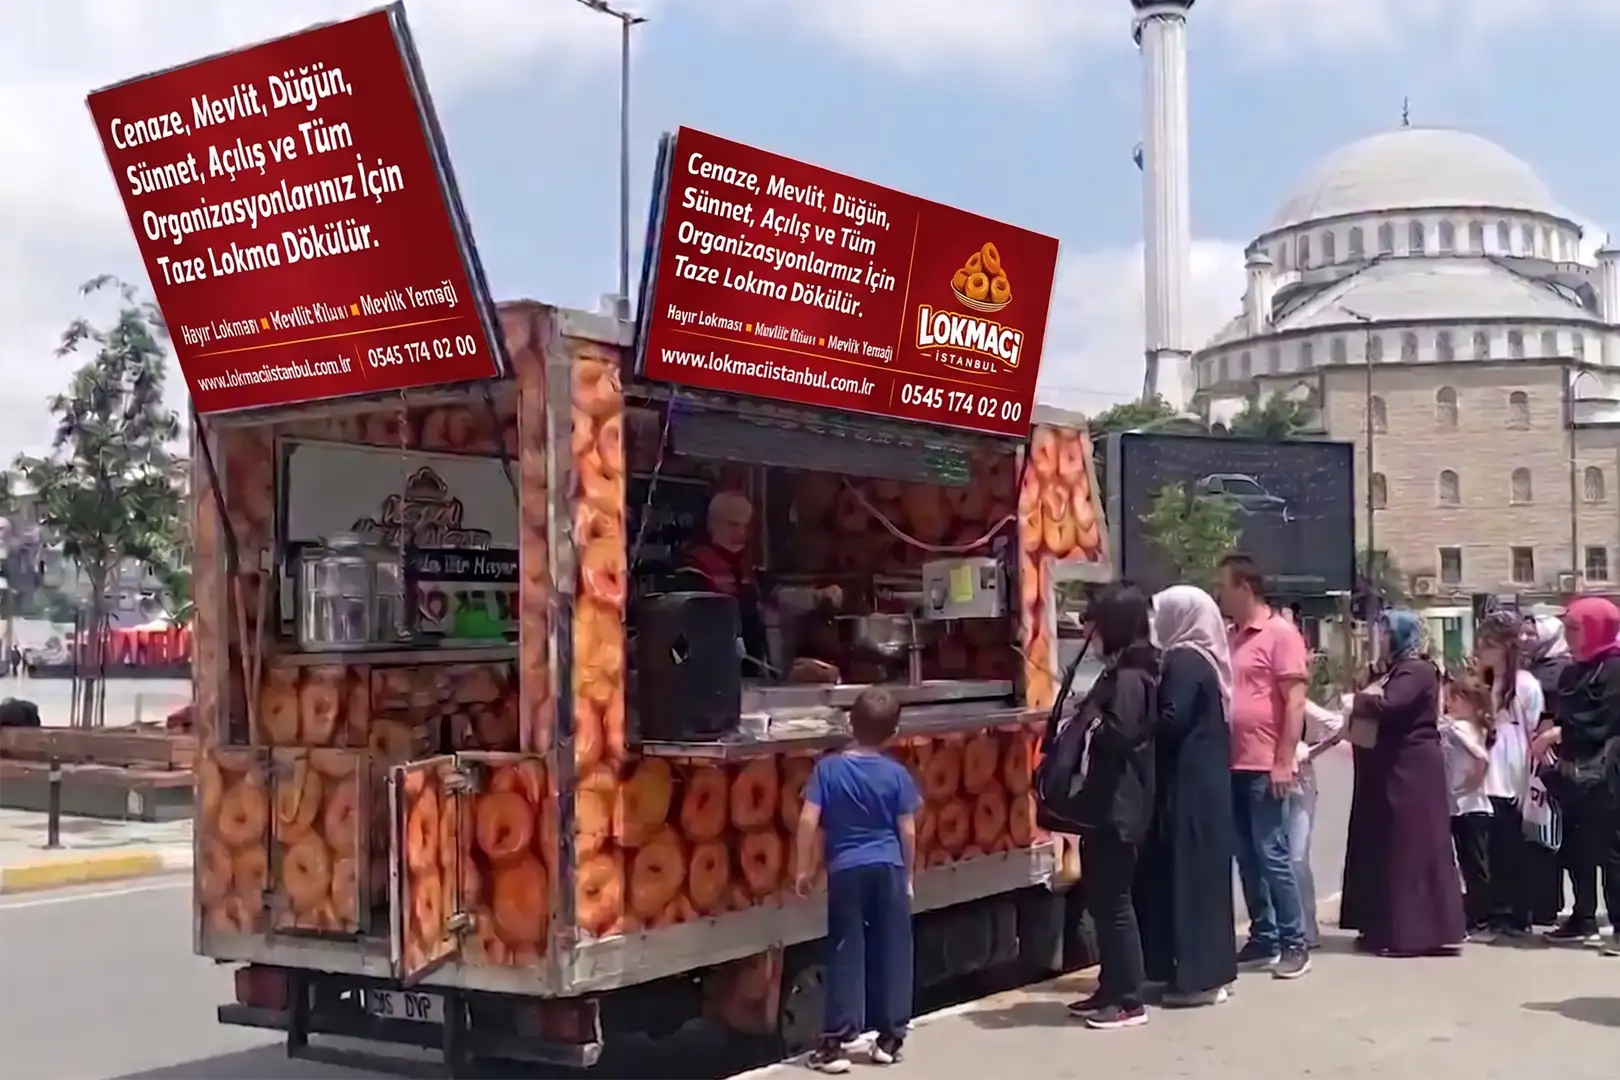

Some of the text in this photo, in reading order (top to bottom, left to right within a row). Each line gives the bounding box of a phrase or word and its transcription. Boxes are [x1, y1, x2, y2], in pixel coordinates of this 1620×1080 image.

[111, 62, 352, 149] Cenaze, Mevlit, Düğün,
[127, 120, 352, 195] Sünnet, Açılış ve Tüm
[143, 155, 404, 245] Organizasyonlarınız İçin
[682, 187, 875, 255] Sünnet, Açılış ve Tüm
[688, 153, 890, 230] Cenaze, Mevlit, Düğün,
[157, 220, 379, 285] Taze Lokma Dökülür.
[864, 260, 895, 294] İçin
[675, 255, 862, 317] Taze Lokma Dökülür.
[181, 324, 210, 347] Hayır
[668, 304, 697, 325] Hayır
[699, 311, 742, 331] Lokması
[368, 335, 476, 367] 0545 174 02 00
[936, 350, 997, 374] İSTANBUL
[902, 384, 1021, 421] 0545 174 02 00
